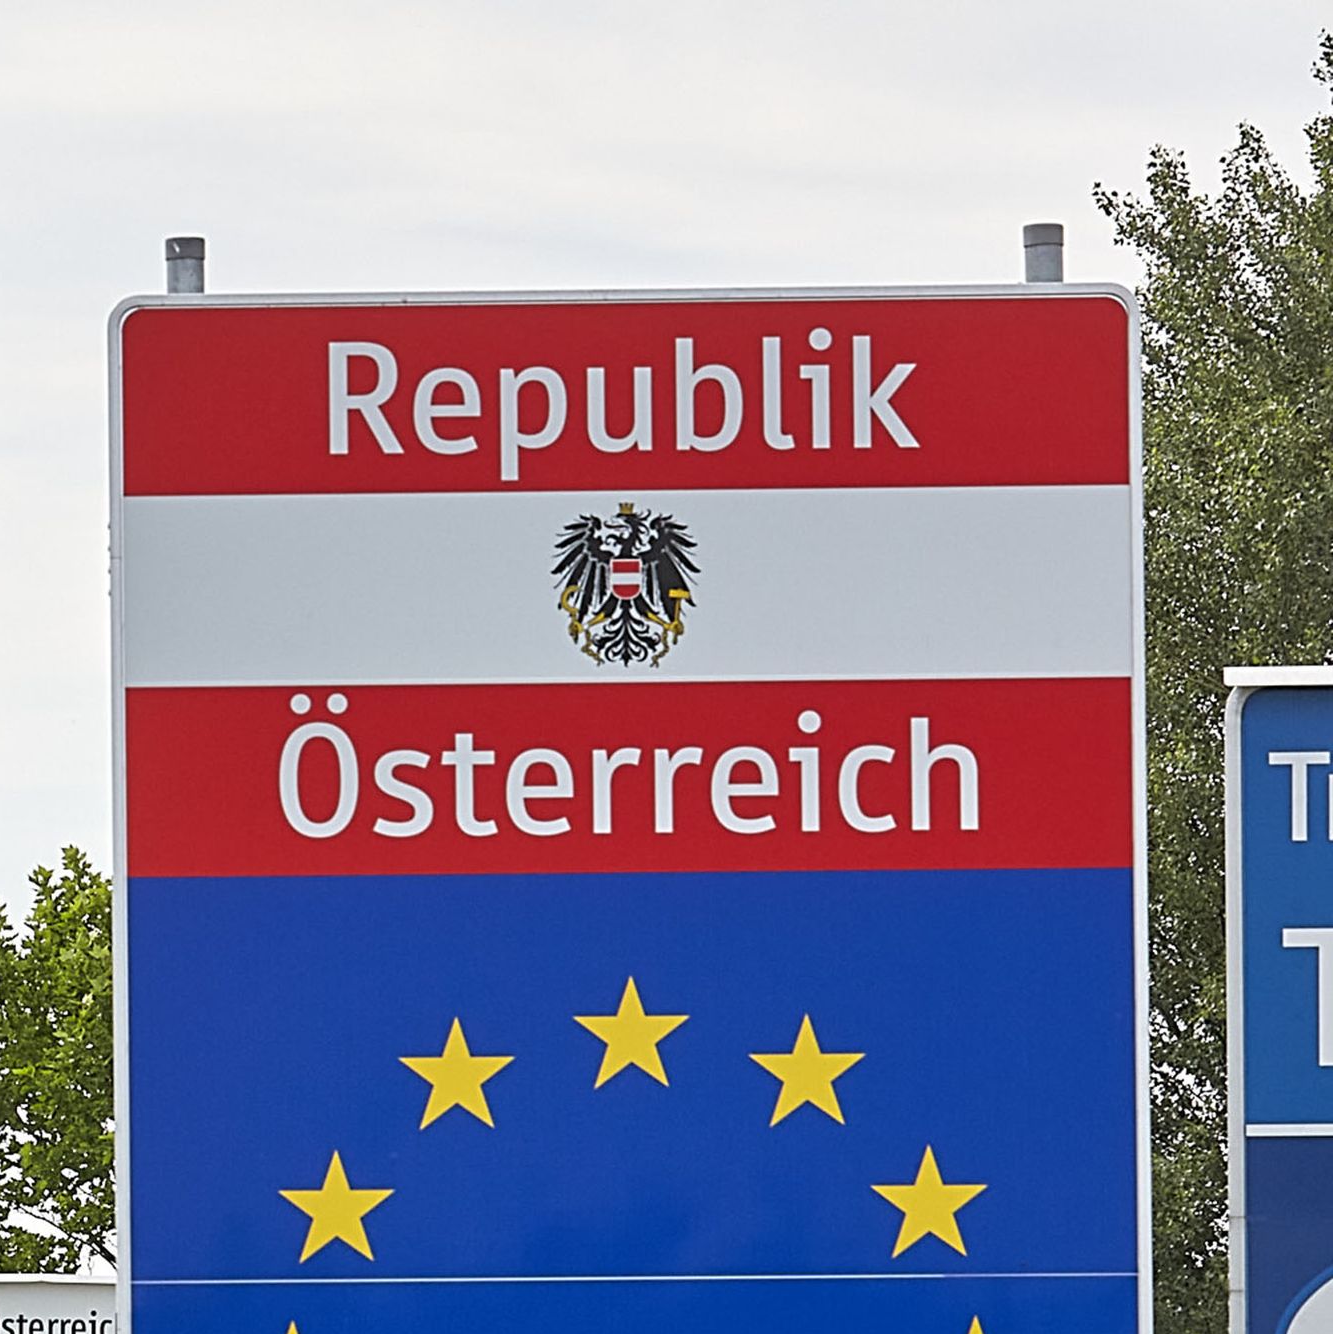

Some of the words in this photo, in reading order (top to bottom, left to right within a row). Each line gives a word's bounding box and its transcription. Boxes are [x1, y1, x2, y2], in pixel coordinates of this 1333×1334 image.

[327, 327, 920, 481] Republik
[278, 692, 980, 839] Österreich
[1269, 751, 1333, 842] T
